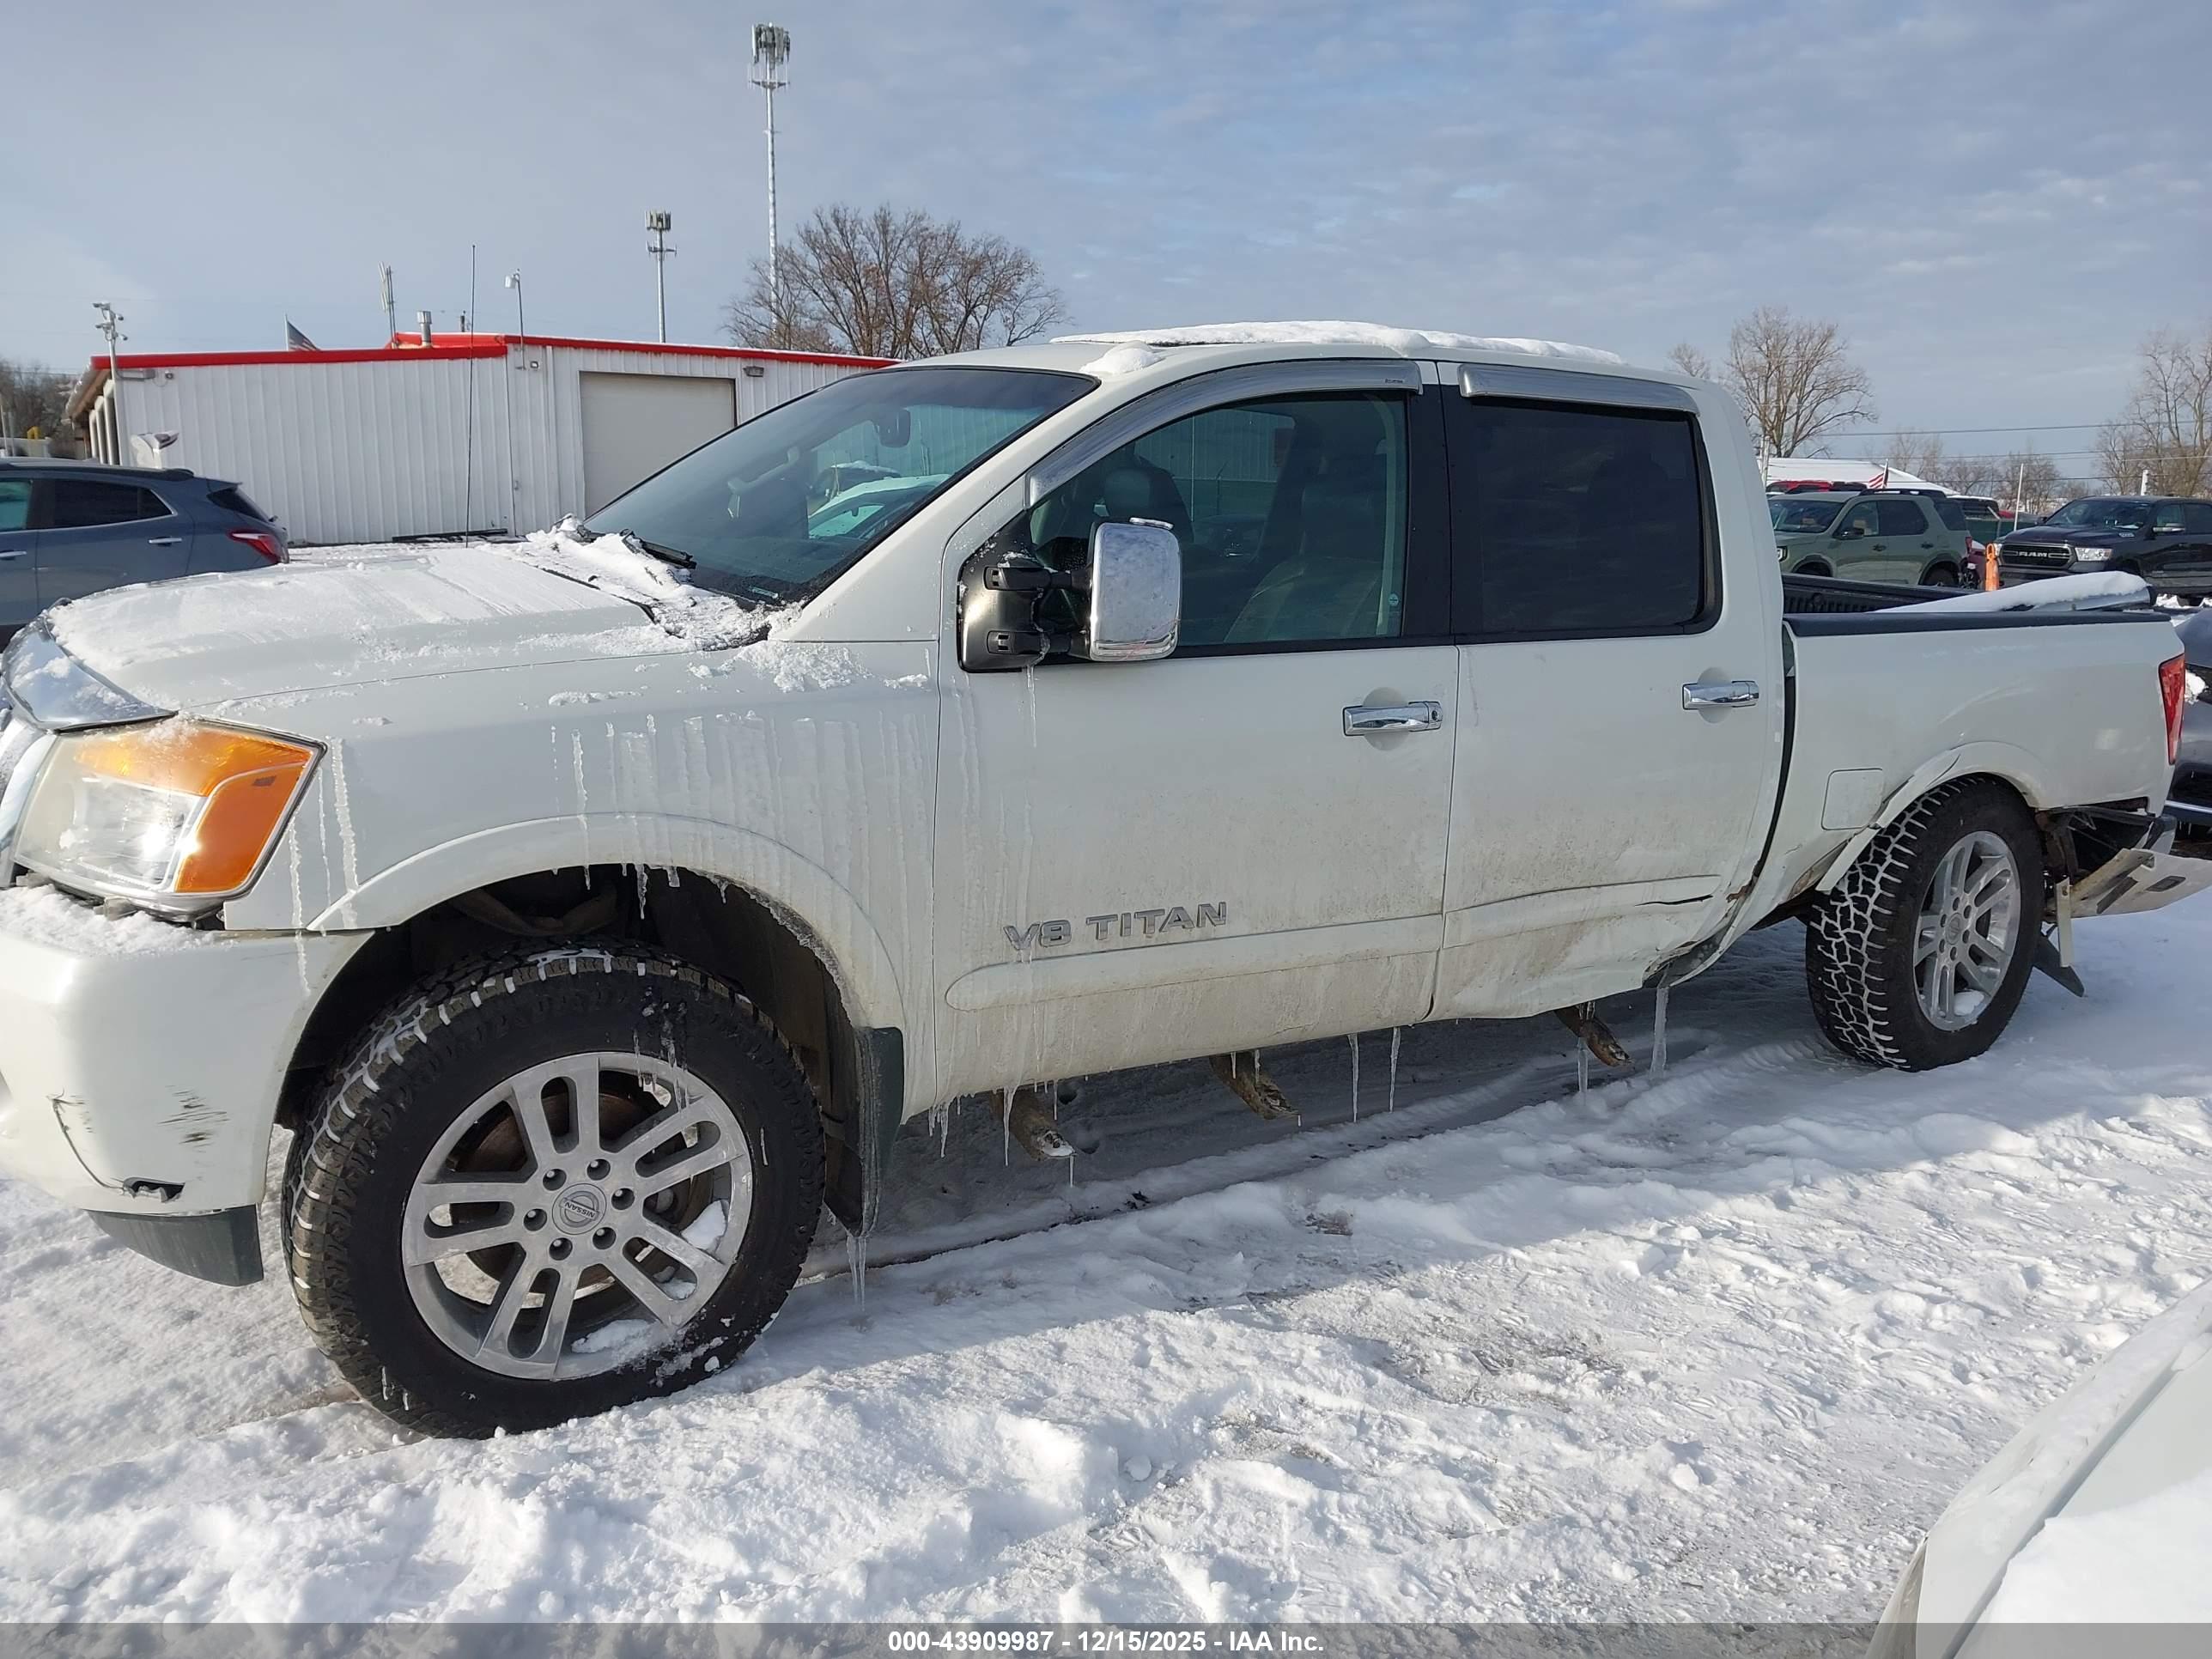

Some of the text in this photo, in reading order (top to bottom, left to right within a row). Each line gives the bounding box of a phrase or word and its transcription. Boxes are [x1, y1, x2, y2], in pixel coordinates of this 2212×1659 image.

[1003, 902, 1227, 951] V8 TITAN
[564, 1201, 596, 1218] NISSAN
